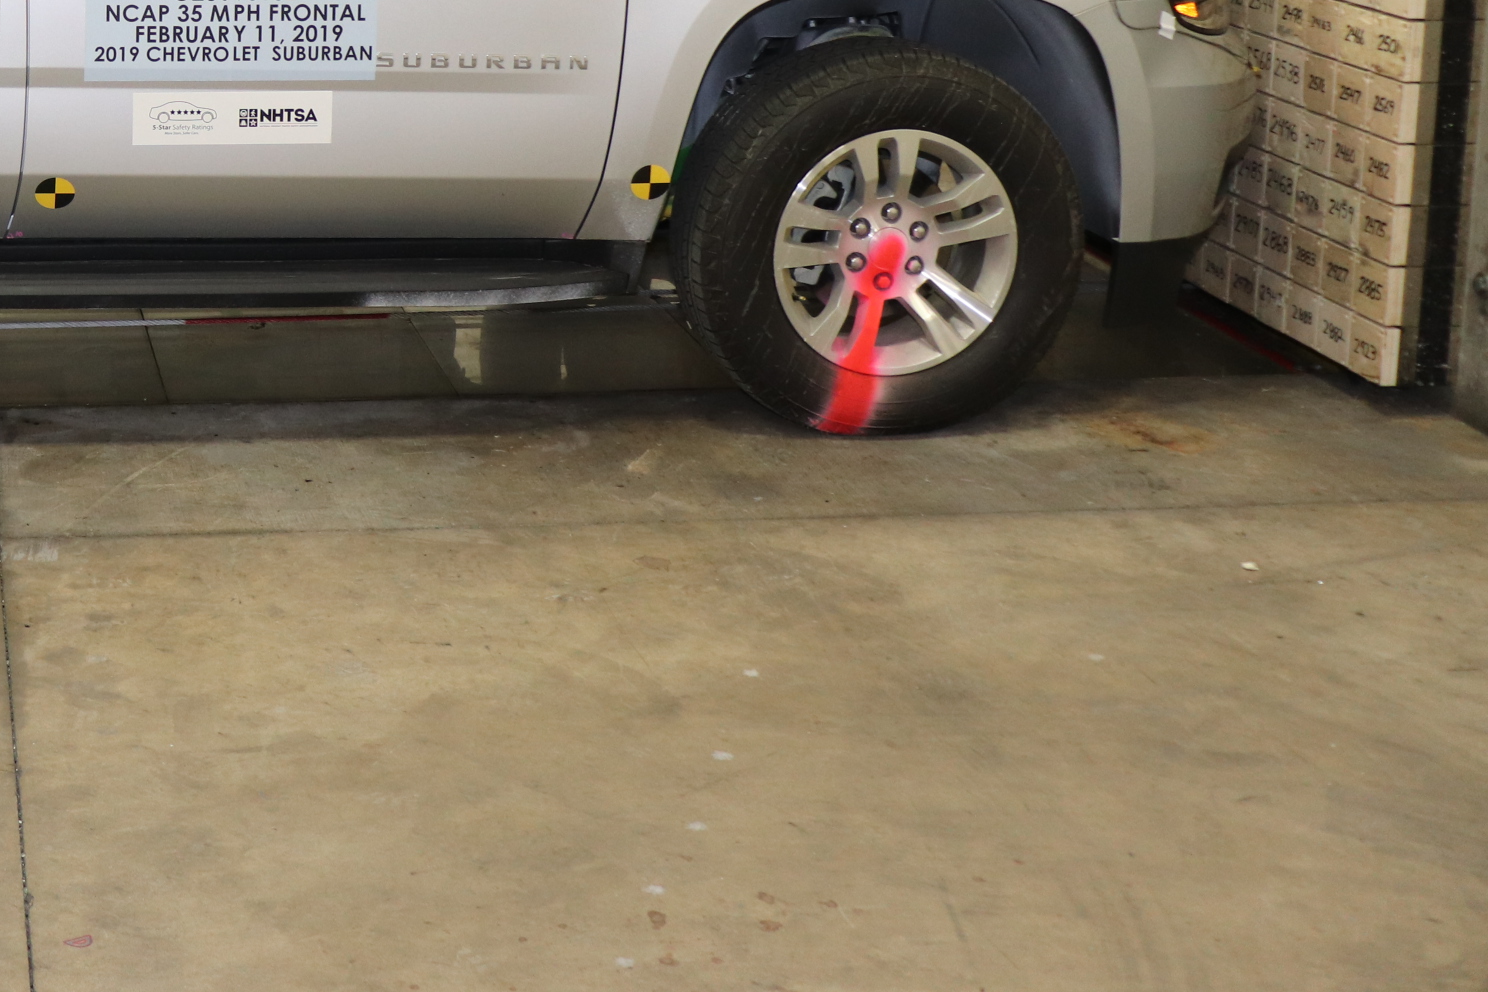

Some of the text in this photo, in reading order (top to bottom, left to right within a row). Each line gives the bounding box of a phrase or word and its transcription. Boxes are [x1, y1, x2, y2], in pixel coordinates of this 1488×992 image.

[105, 3, 366, 22] NCAP 35 MPH FRONTAL
[135, 24, 344, 45] FEBRUARY 11, 2019
[94, 45, 373, 63] 2019 CHEVROLET SUBURBAN
[376, 51, 589, 71] SUBURBAN
[259, 108, 318, 122] NHTSA
[172, 124, 191, 132] Safety
[192, 124, 214, 132] Ratings
